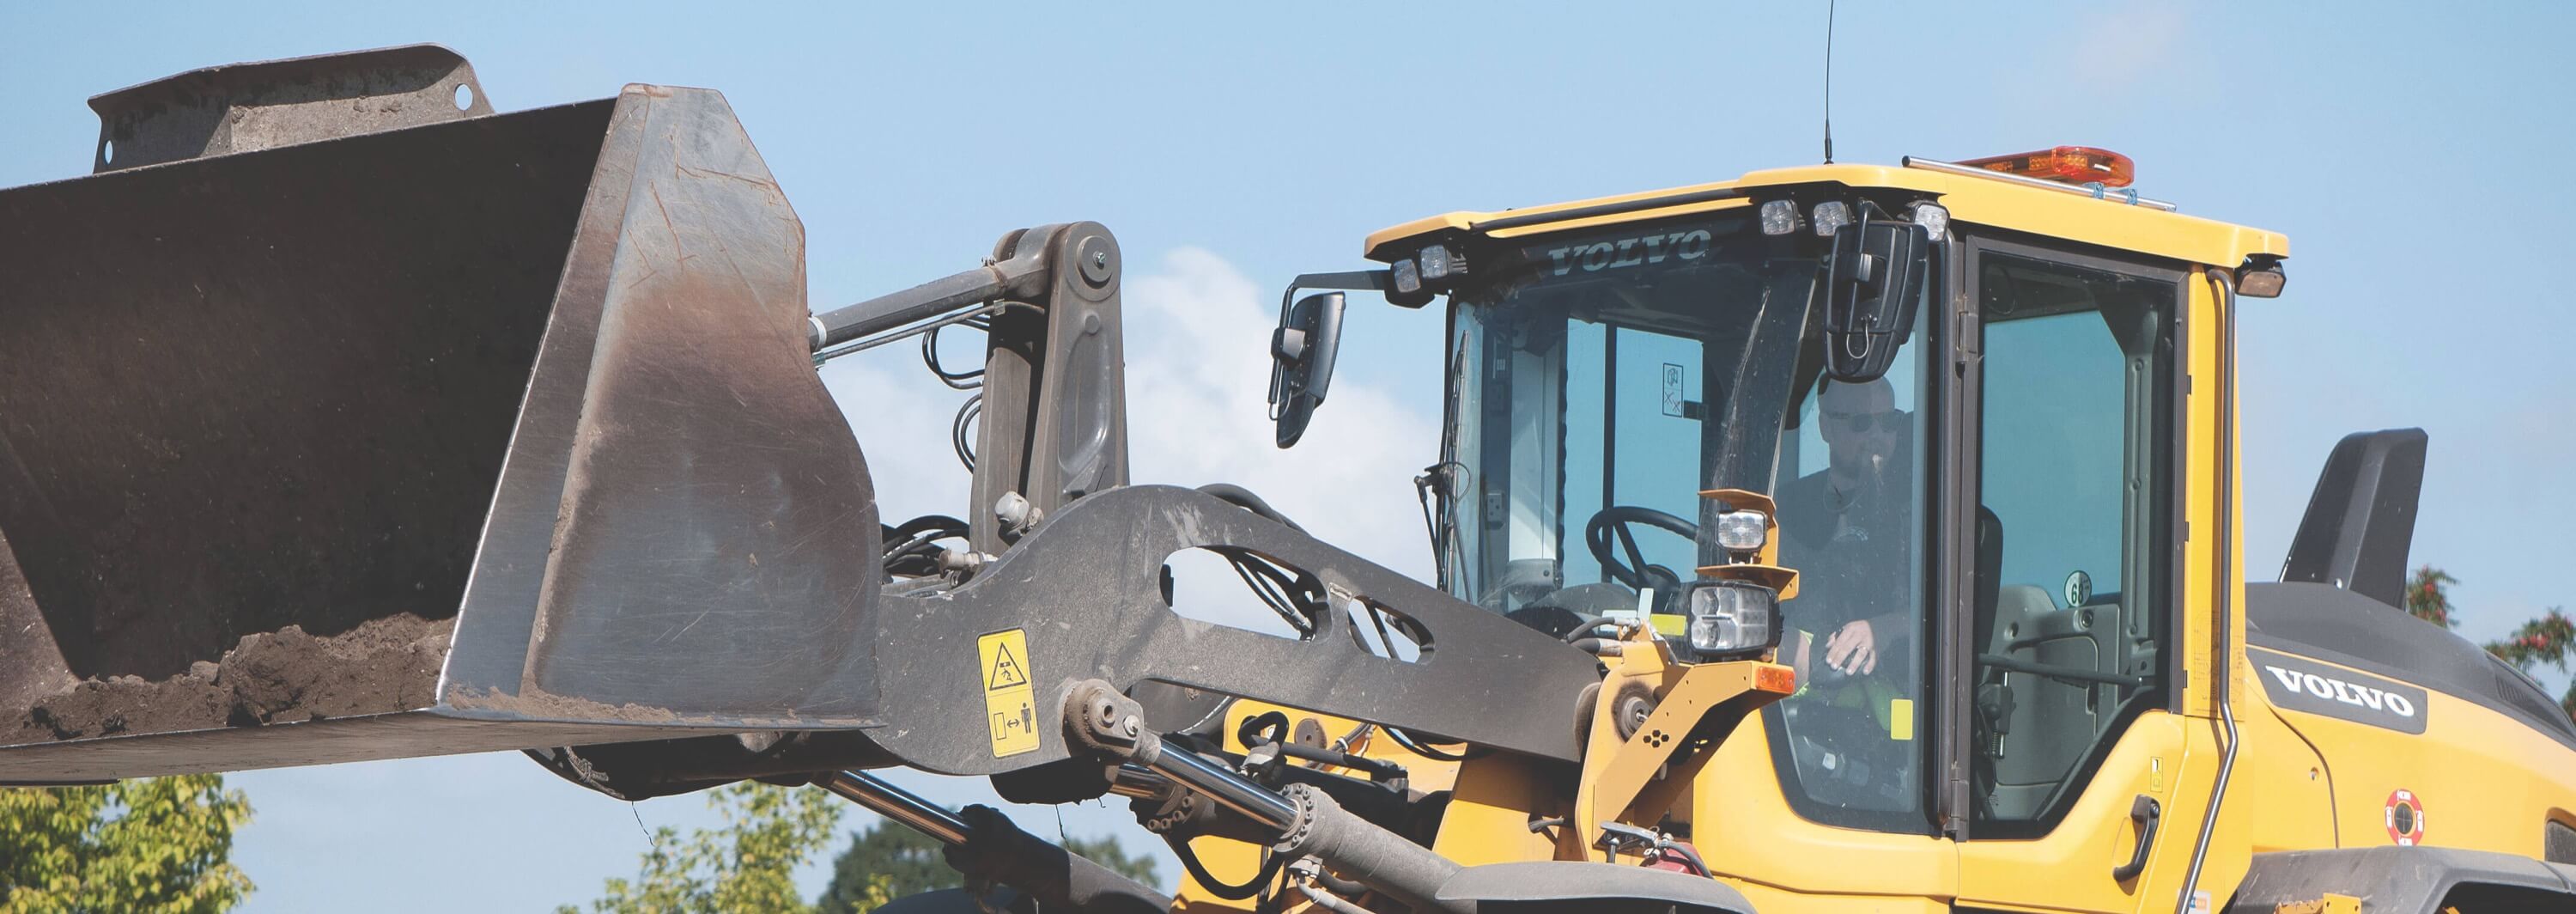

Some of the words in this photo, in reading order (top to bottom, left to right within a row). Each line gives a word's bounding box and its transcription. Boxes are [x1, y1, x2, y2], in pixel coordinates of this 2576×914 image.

[1548, 229, 1711, 276] VOLVO
[2071, 583, 2083, 604] 68
[2265, 665, 2415, 717] VOLVO
